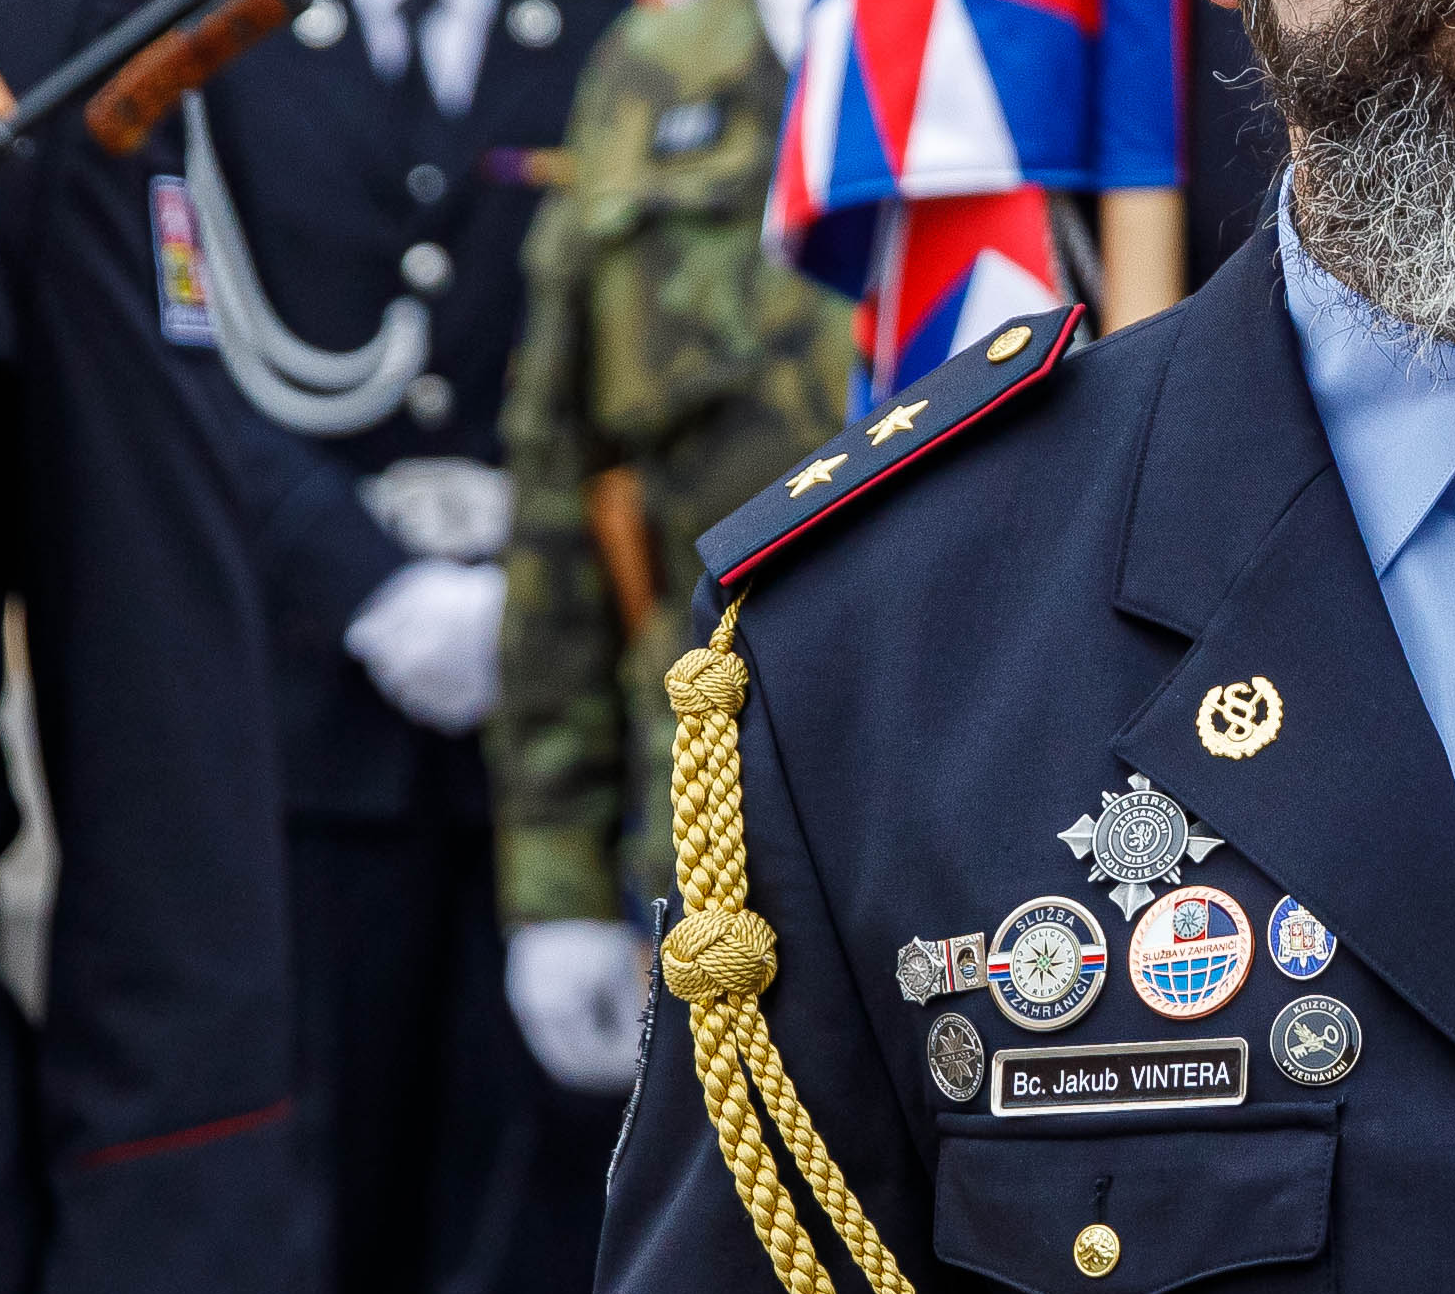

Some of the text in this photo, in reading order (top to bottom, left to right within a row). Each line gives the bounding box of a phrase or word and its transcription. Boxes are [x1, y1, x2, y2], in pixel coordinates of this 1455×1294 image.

[1112, 795, 1177, 818] VETERAN
[1100, 851, 1153, 879] POLICIE
[1015, 907, 1075, 932] SLUŽBA
[1025, 930, 1067, 945] POLICIE
[1142, 949, 1178, 962] SLUŽBA
[1179, 948, 1186, 956] V
[1003, 976, 1091, 1017] V ZAHRANIČÍ
[1293, 1000, 1342, 1016] KRIZOVÉ
[1013, 1061, 1231, 1096] Bc. Jakub VINTERA
